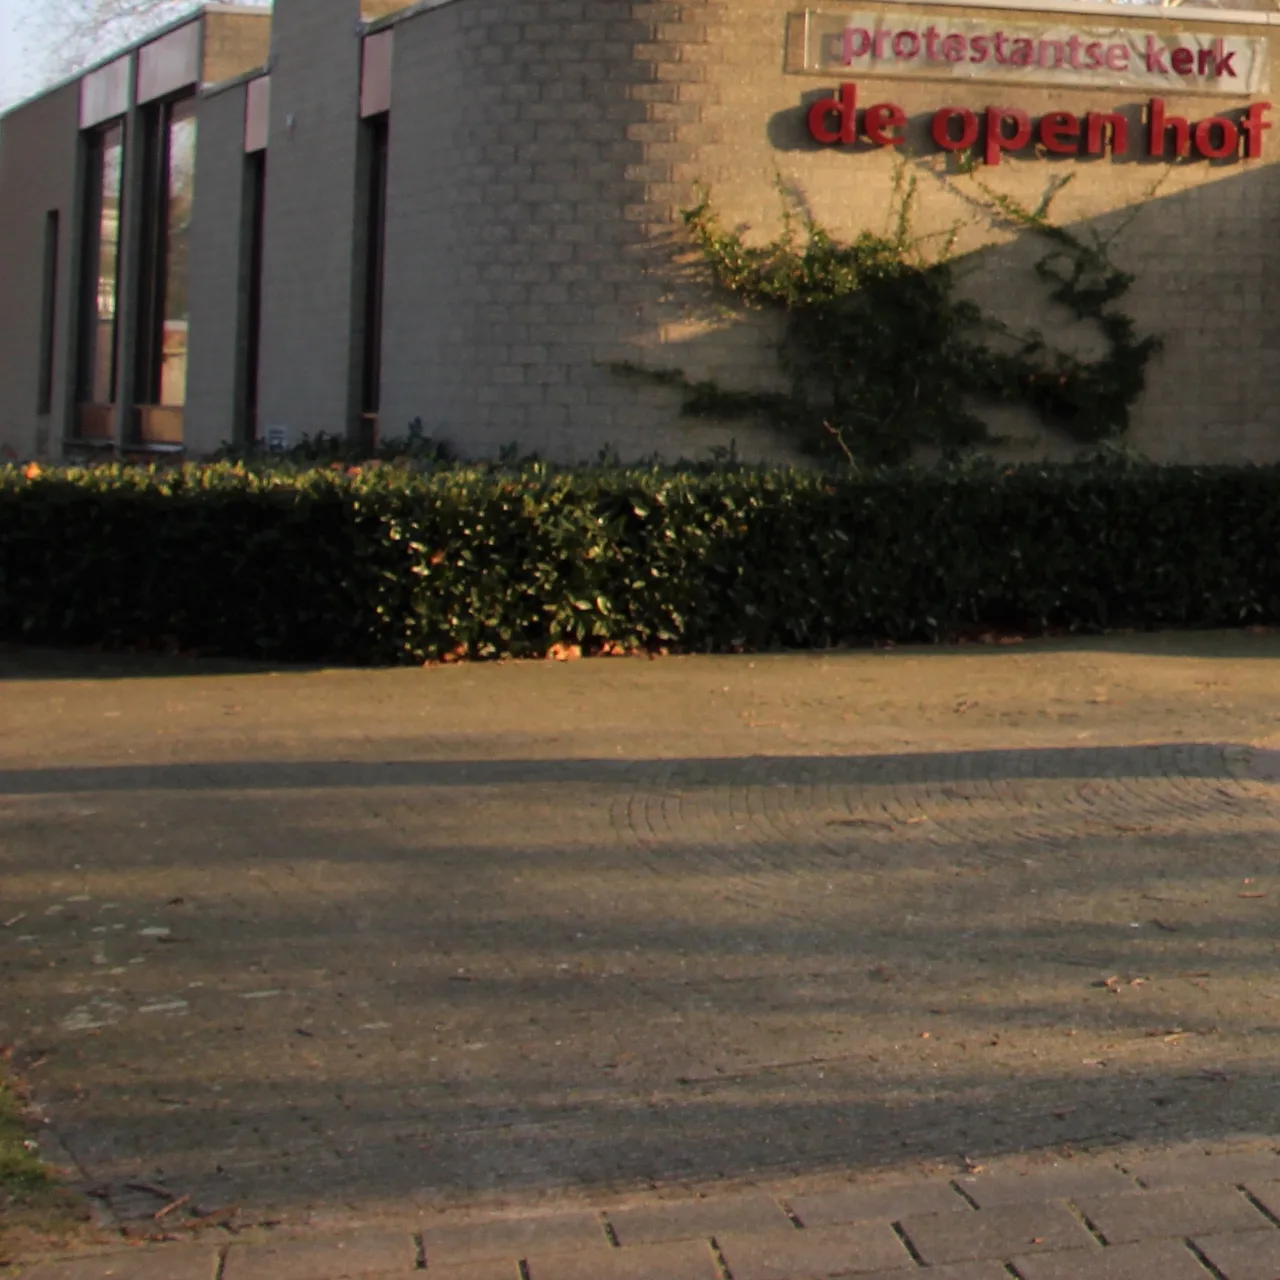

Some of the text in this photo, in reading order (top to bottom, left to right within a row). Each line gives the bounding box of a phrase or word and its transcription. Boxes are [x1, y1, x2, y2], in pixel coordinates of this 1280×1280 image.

[841, 24, 1237, 78] protestantse kerk
[807, 83, 1273, 165] de open hof
